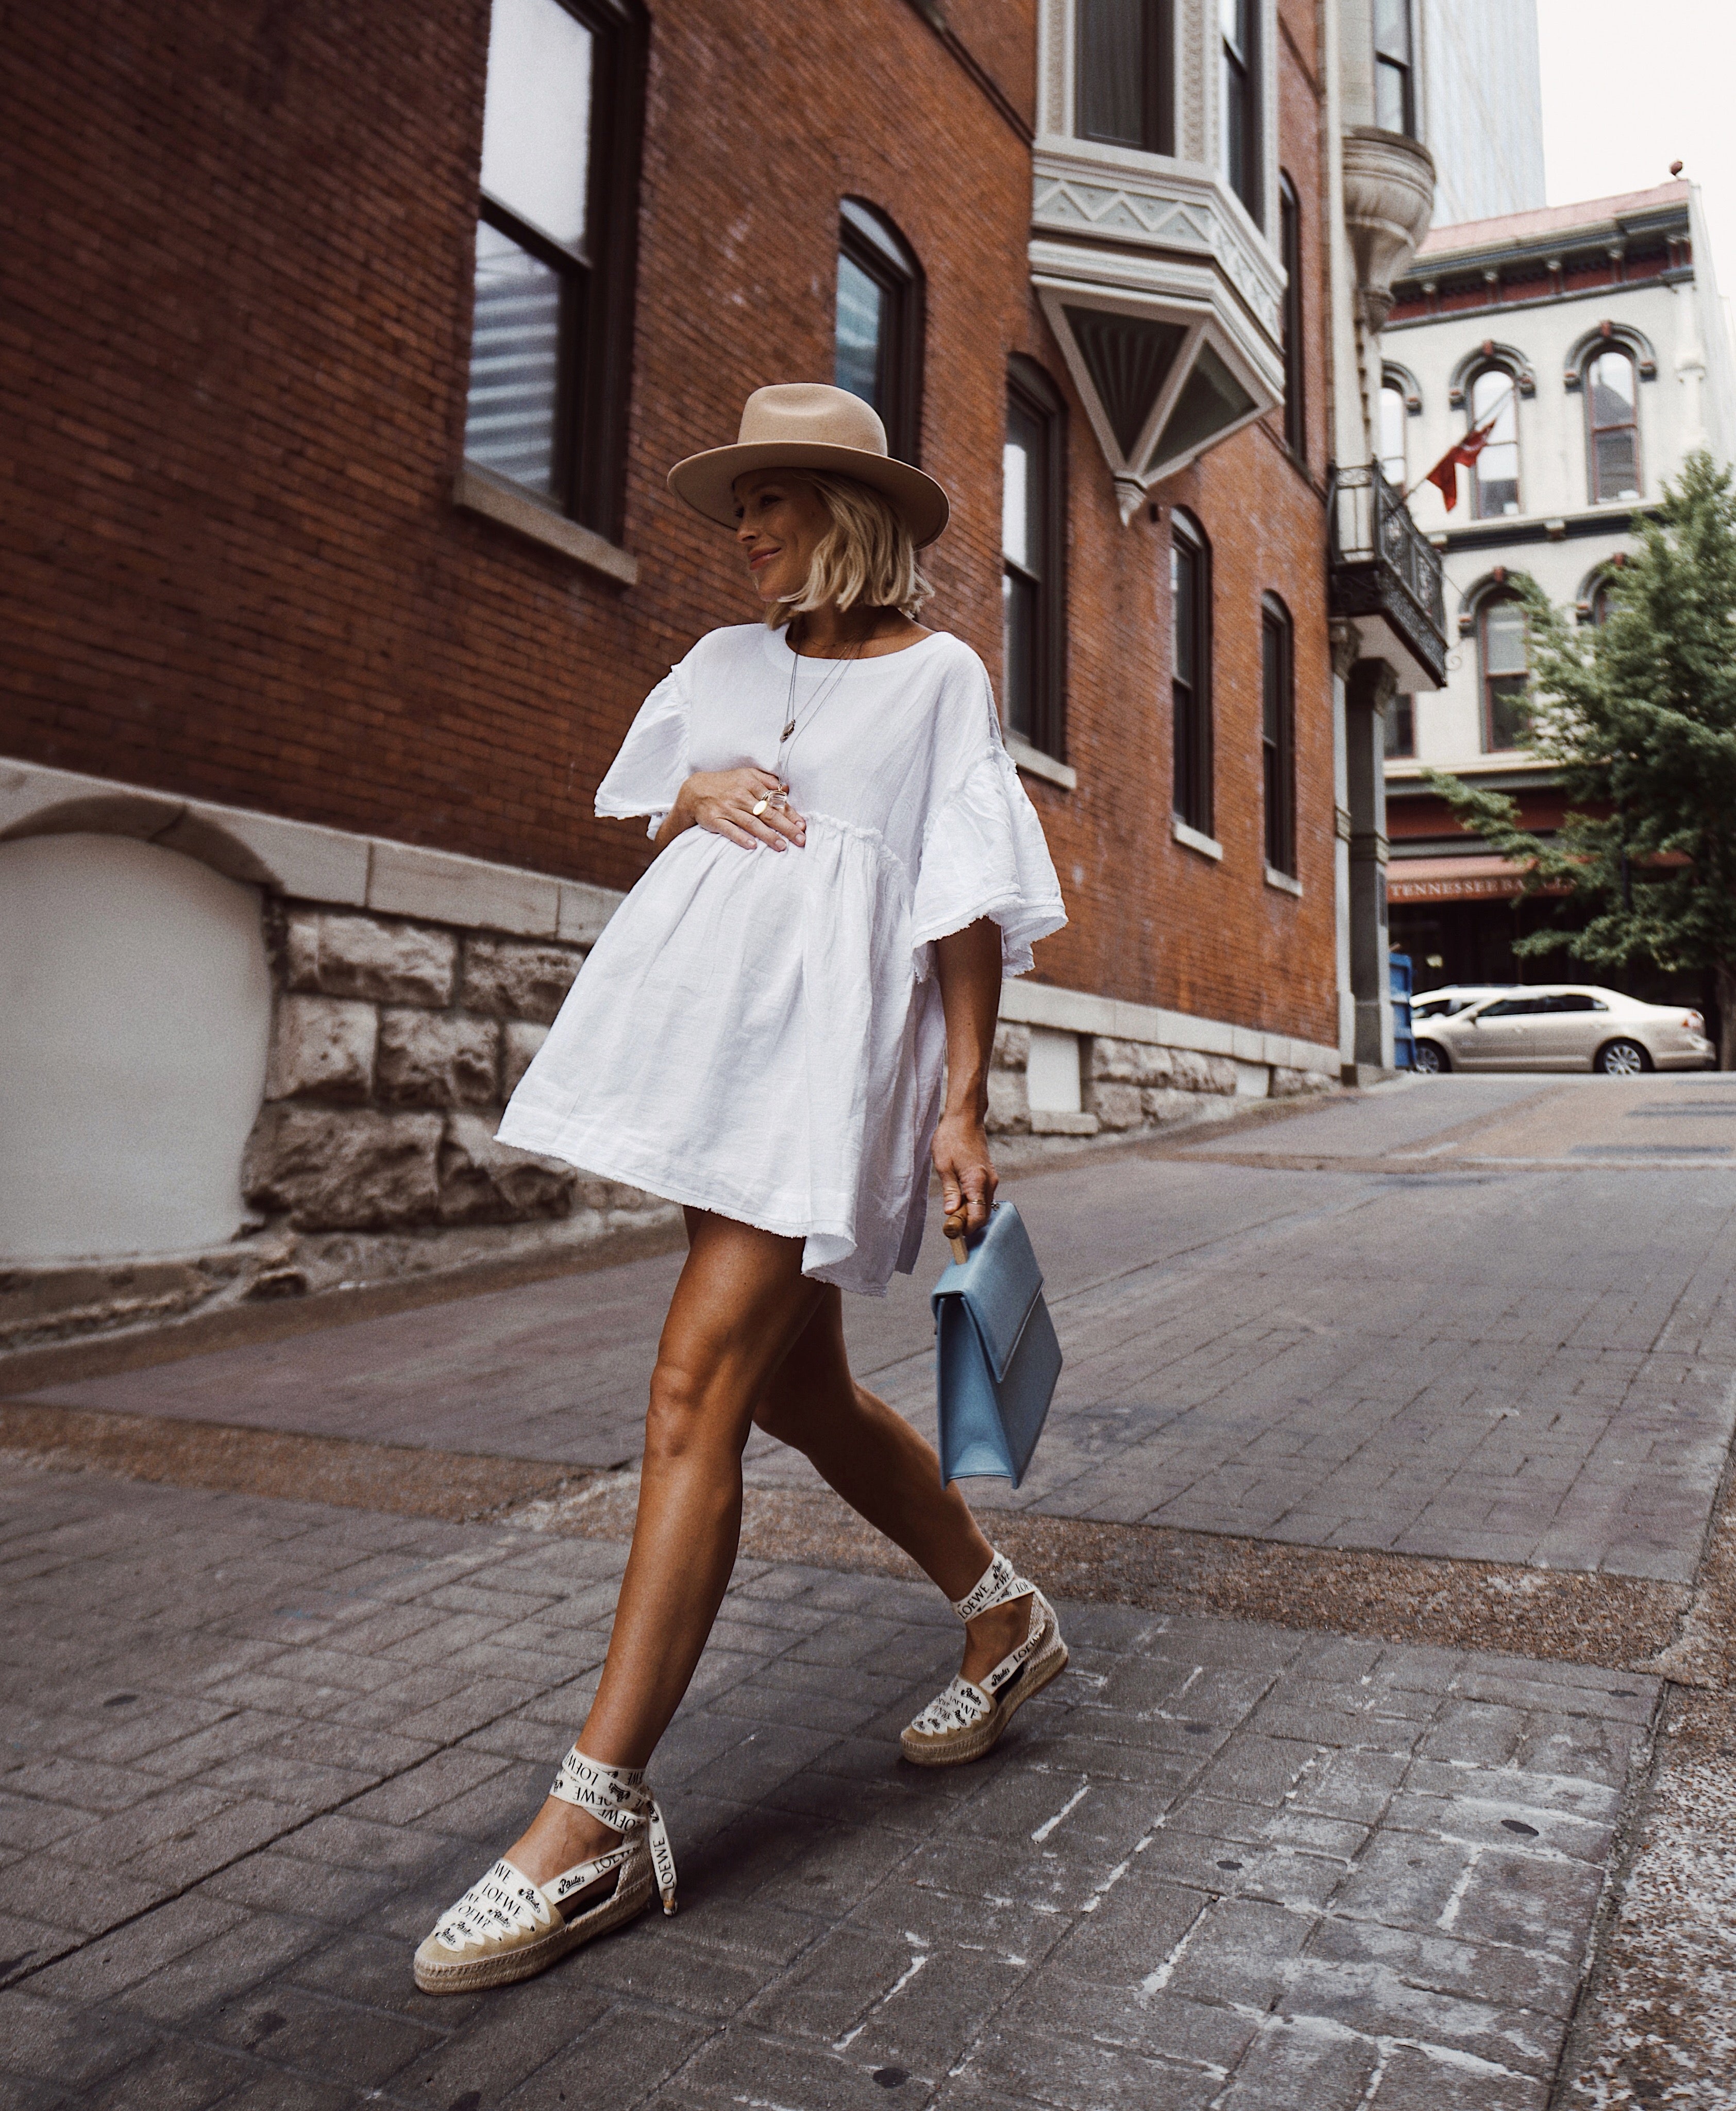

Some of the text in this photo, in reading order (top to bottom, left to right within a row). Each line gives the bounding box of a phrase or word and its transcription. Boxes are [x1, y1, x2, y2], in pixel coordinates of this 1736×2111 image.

[1391, 879, 1498, 896] TENNESSEE
[957, 1583, 990, 1620] LOEWE
[653, 1837, 675, 1891] LOEWE
[481, 1883, 524, 1920] LOEWE
[558, 1875, 585, 1896] Paula's
